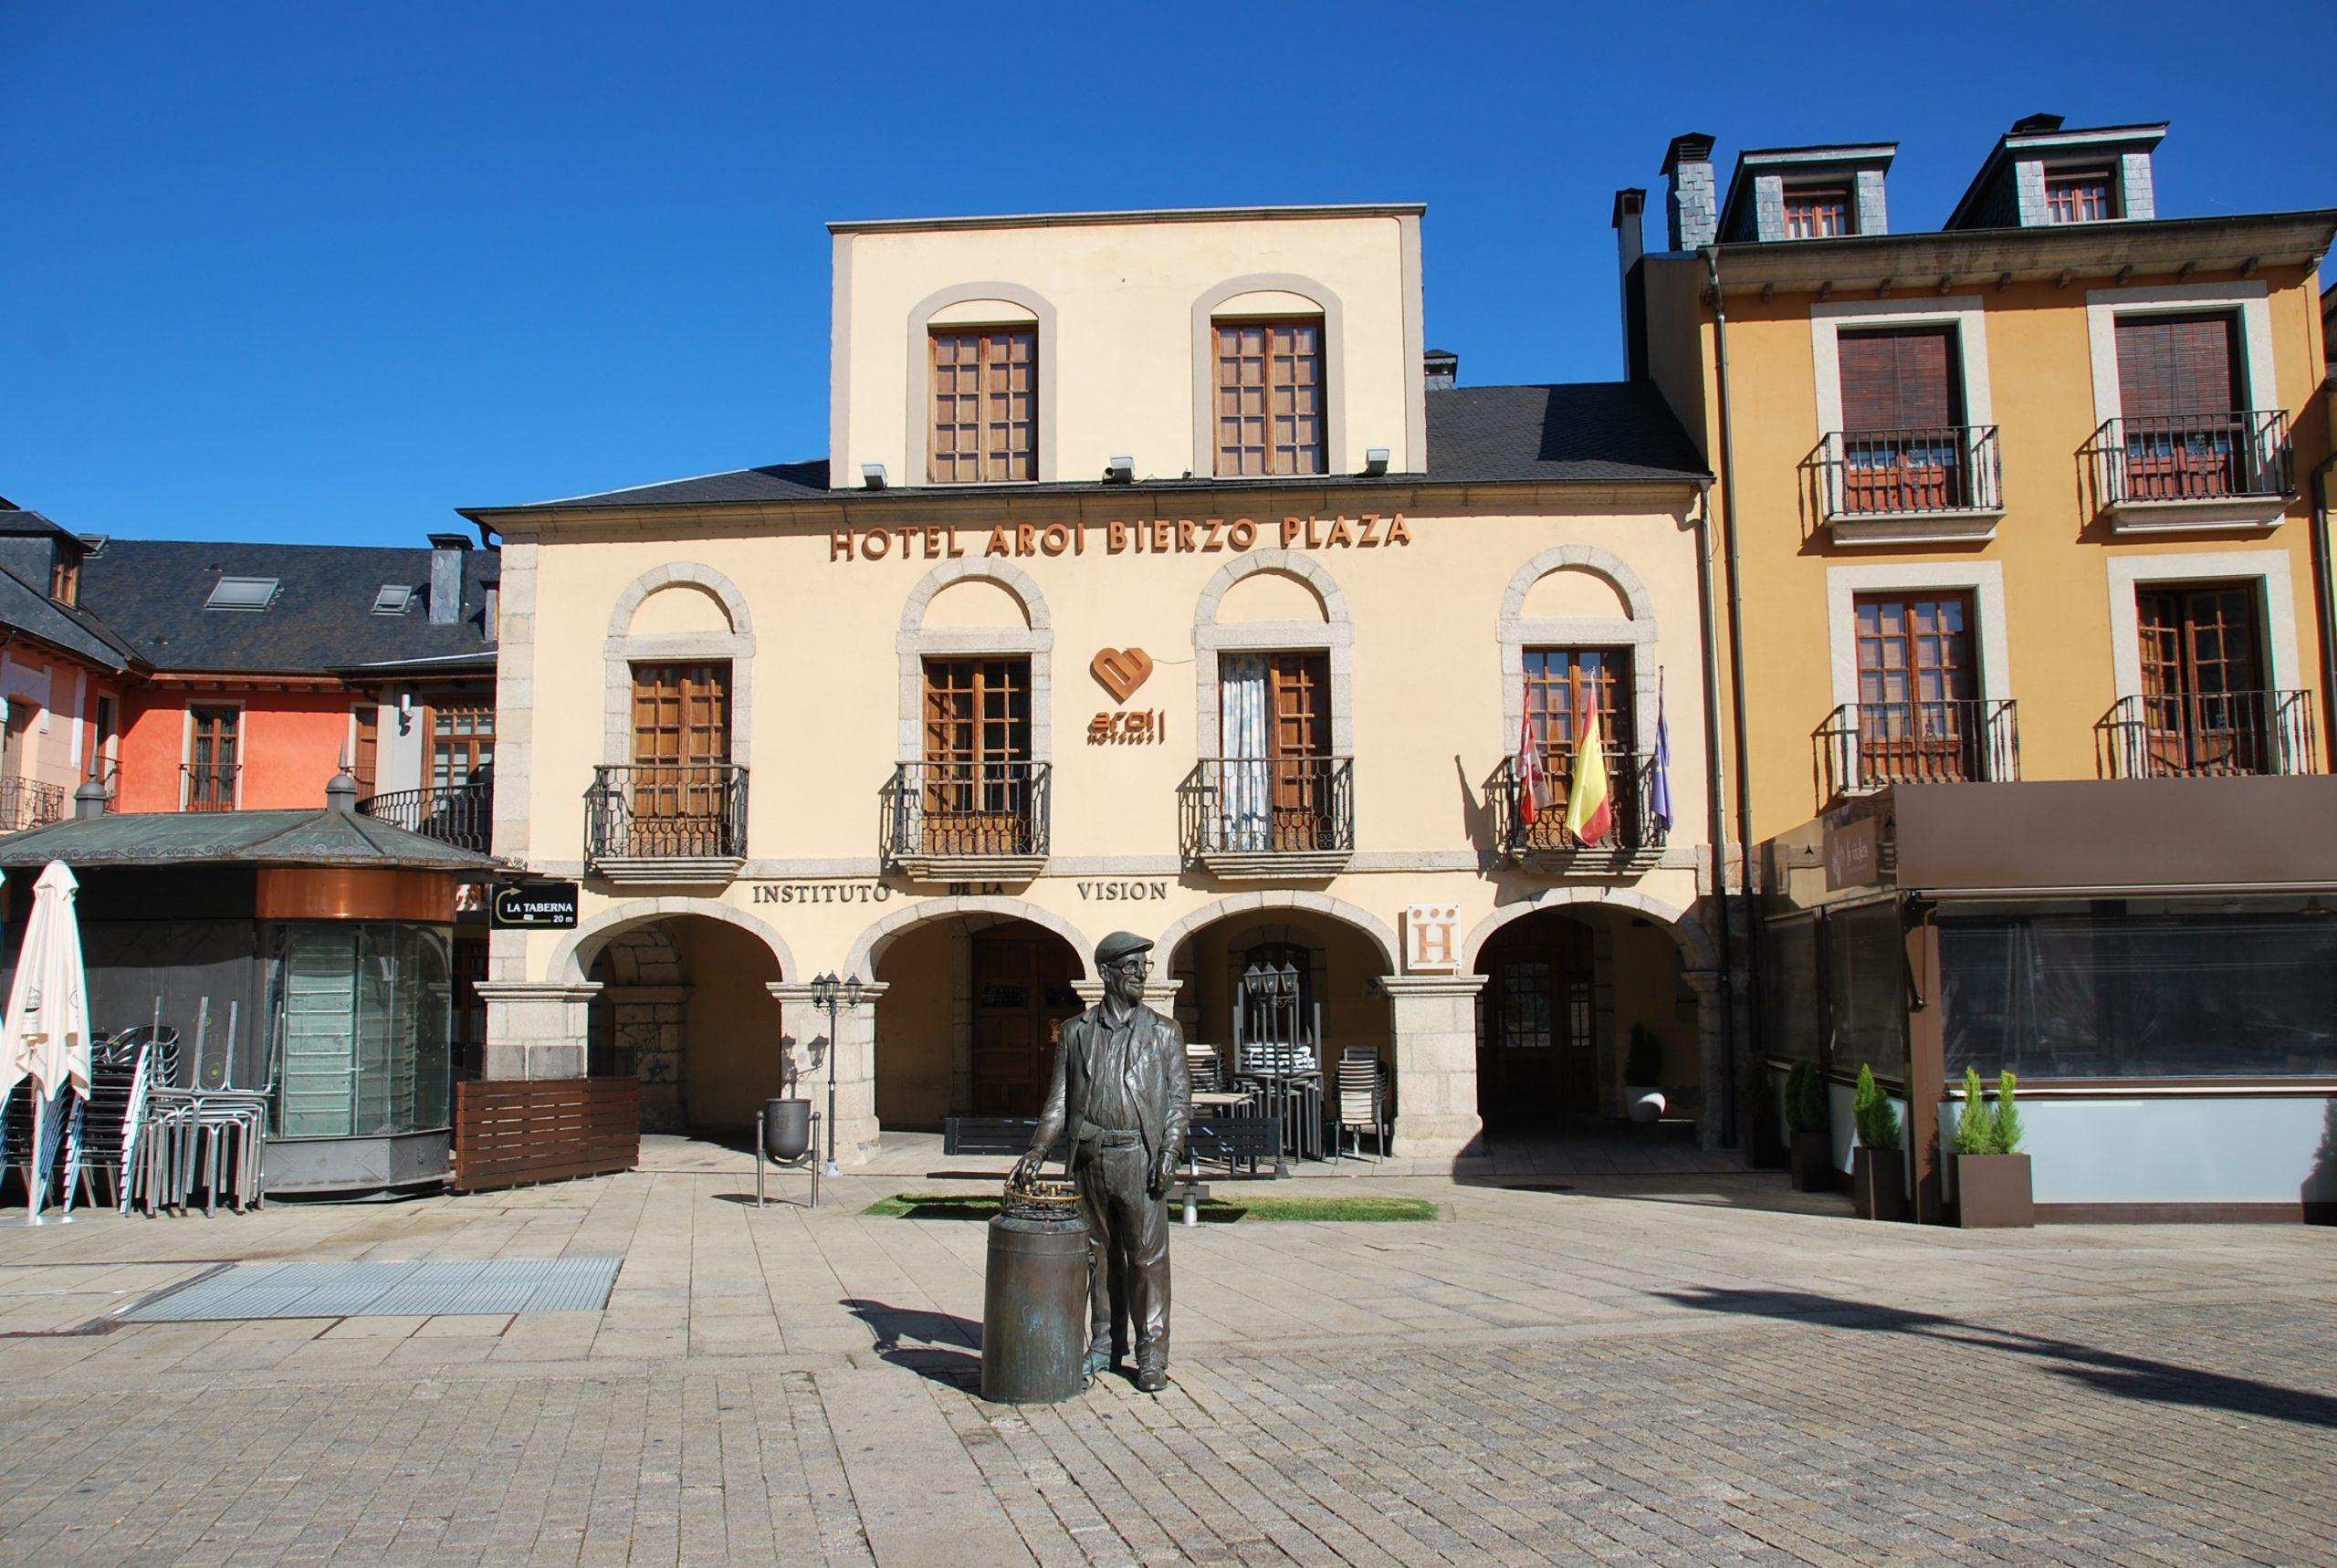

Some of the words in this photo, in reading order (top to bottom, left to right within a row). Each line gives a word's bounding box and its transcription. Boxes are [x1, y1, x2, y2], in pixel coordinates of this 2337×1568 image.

[831, 525, 964, 560] HOTEL
[986, 523, 1085, 556] AROI
[1107, 518, 1258, 553] BIERZO
[1281, 513, 1412, 549] PLAZA
[1089, 708, 1154, 732] aroi
[752, 883, 892, 903] INSTITUTO
[949, 882, 970, 895] DE
[982, 882, 1004, 895] LA
[1076, 882, 1168, 901] VISION
[507, 903, 521, 913] LA
[523, 903, 573, 913] TABERNA
[553, 915, 564, 923] 20
[1411, 923, 1457, 964] H
